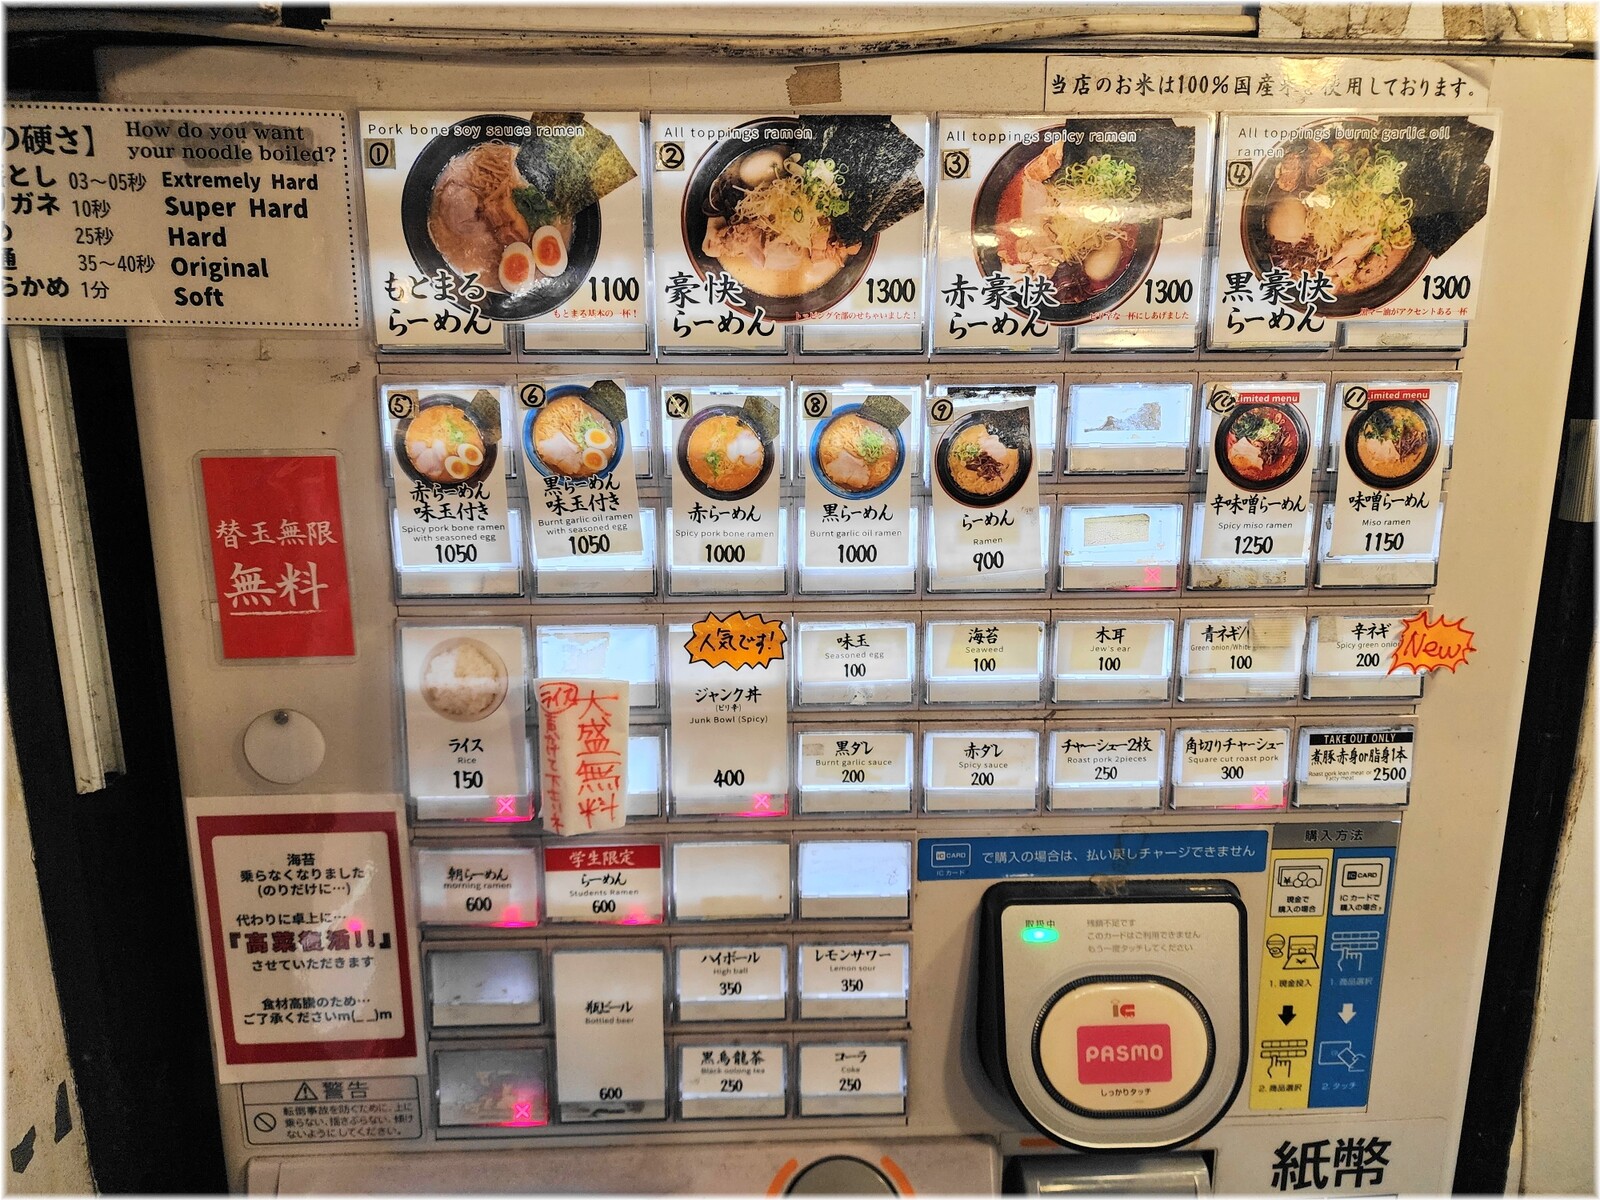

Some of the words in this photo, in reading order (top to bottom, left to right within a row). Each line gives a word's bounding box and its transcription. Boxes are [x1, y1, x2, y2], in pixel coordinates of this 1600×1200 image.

[126, 121, 169, 137] How
[177, 123, 203, 139] do
[210, 126, 247, 142] you
[254, 125, 304, 140] want
[368, 123, 403, 135] Pork
[410, 123, 450, 136] bone
[453, 125, 481, 139] soy
[486, 124, 531, 137] sauce
[536, 124, 585, 137] ramen
[946, 131, 966, 142] All
[972, 131, 1040, 145] toppings
[1043, 131, 1085, 145] spicy
[1089, 131, 1136, 143] ramen
[1238, 127, 1257, 139] All
[1264, 126, 1331, 141] toppings
[1335, 126, 1378, 140] burnt
[1381, 126, 1424, 141] garlic
[1429, 125, 1450, 140] oil
[127, 145, 174, 160] your
[182, 144, 252, 160] noodle
[260, 146, 336, 163] boiled?
[1238, 146, 1284, 158] ramen
[162, 171, 261, 192] Extremely
[272, 173, 319, 191] Hard
[72, 199, 111, 219] 10秒
[165, 197, 237, 221] Super
[250, 198, 308, 218] Hard
[75, 227, 114, 246] 25秒
[168, 227, 227, 247] Hard
[171, 257, 269, 282] Original
[81, 282, 110, 299] 1分
[175, 287, 225, 307] Soft
[384, 269, 486, 303] もとまる
[588, 276, 640, 302] 1100
[664, 271, 746, 308] 豪快
[865, 277, 916, 304] 1300
[941, 272, 1061, 310] 赤豪快
[1144, 278, 1193, 304] 1300
[1222, 269, 1337, 305] 黒豪快
[1422, 274, 1471, 300] 1300
[388, 304, 492, 337] らーめん
[672, 306, 775, 338] らーめん
[948, 308, 1049, 340] らーめん
[1226, 304, 1325, 335] らーめん
[409, 479, 491, 503] 赤らーめん
[543, 472, 621, 497] 黒らーめん
[546, 492, 620, 516] 味玉付き
[1210, 494, 1307, 516] 辛味噌らーめん
[1348, 491, 1430, 511] 味噌らーめん
[413, 501, 489, 522] 味玉付き
[688, 502, 762, 524] 赤らーめん
[822, 503, 894, 523] 黒らーめん
[962, 509, 1015, 531] らーめん
[401, 525, 426, 534] Spicy
[428, 525, 449, 534] pork
[451, 524, 475, 532] bone
[477, 523, 506, 531] ramen
[1218, 522, 1241, 530] Spicy
[1243, 521, 1263, 529] miso
[1384, 518, 1411, 526] ramen
[215, 519, 337, 550] 替玉無限
[413, 534, 433, 542] with
[435, 533, 477, 541] seasoned
[480, 533, 497, 542] egg
[973, 537, 1003, 546] Ramen
[1365, 532, 1404, 552] 1150
[435, 544, 477, 563] 1050
[568, 534, 611, 555] 1050
[705, 544, 745, 563] 1000
[838, 544, 877, 563] 1000
[1234, 535, 1273, 554] 1250
[973, 550, 1004, 572] 900
[223, 561, 329, 610] 無料
[968, 627, 1000, 645] 海苔
[1095, 626, 1127, 645] 木耳
[1351, 622, 1392, 641] 辛ネギ
[837, 633, 870, 650] 味玉
[1403, 632, 1462, 660] New
[825, 651, 867, 660] Seasoned
[869, 651, 884, 660] egg
[1098, 657, 1121, 671] 100
[1230, 655, 1252, 669] 100
[1356, 653, 1380, 667] 200
[844, 663, 866, 677] 100
[973, 658, 996, 672] 100
[694, 686, 762, 703] ジャンク丼
[690, 716, 711, 724] Junk
[738, 715, 768, 724] (Spicy)
[448, 738, 484, 753] ライス
[1324, 733, 1347, 744] TAKE
[1350, 733, 1369, 744] OUT
[1372, 732, 1396, 743] ONLY
[834, 741, 874, 757] 黒ダレ
[964, 742, 1004, 760] 赤ダレ
[575, 689, 622, 829] 大盛無料
[1188, 756, 1218, 764] Square
[1221, 755, 1234, 763] cut
[1256, 755, 1279, 763] pork
[453, 771, 484, 789] 150
[713, 769, 745, 788] 400
[842, 769, 865, 784] 200
[971, 772, 995, 787] 200
[1094, 766, 1118, 780] 250
[1221, 766, 1244, 780] 300
[1373, 767, 1407, 781] 2500
[1304, 829, 1364, 842] 購入方法
[287, 854, 315, 866] 海苔
[569, 850, 635, 867] 学生限定
[240, 867, 365, 882] 乗らなくなりました
[447, 867, 509, 882] 朝らーめん
[581, 872, 627, 886] らーめん
[443, 882, 481, 891] morning
[483, 882, 512, 890] ramen
[569, 889, 608, 897] Students
[610, 888, 639, 896] Ramen
[466, 897, 492, 911] 600
[593, 899, 616, 913] 600
[252, 956, 374, 971] させていただきます
[701, 951, 760, 964] ハイボール
[814, 949, 892, 963] レモンサワー
[719, 982, 742, 995] 350
[841, 979, 864, 992] 350
[834, 1051, 868, 1063] コーラ
[1085, 1043, 1164, 1063] PASMO
[322, 1081, 369, 1099] 警告
[599, 1088, 623, 1100] 600
[720, 1079, 743, 1093] 250
[839, 1078, 861, 1092] 250
[1271, 1137, 1392, 1191] 紙幣
